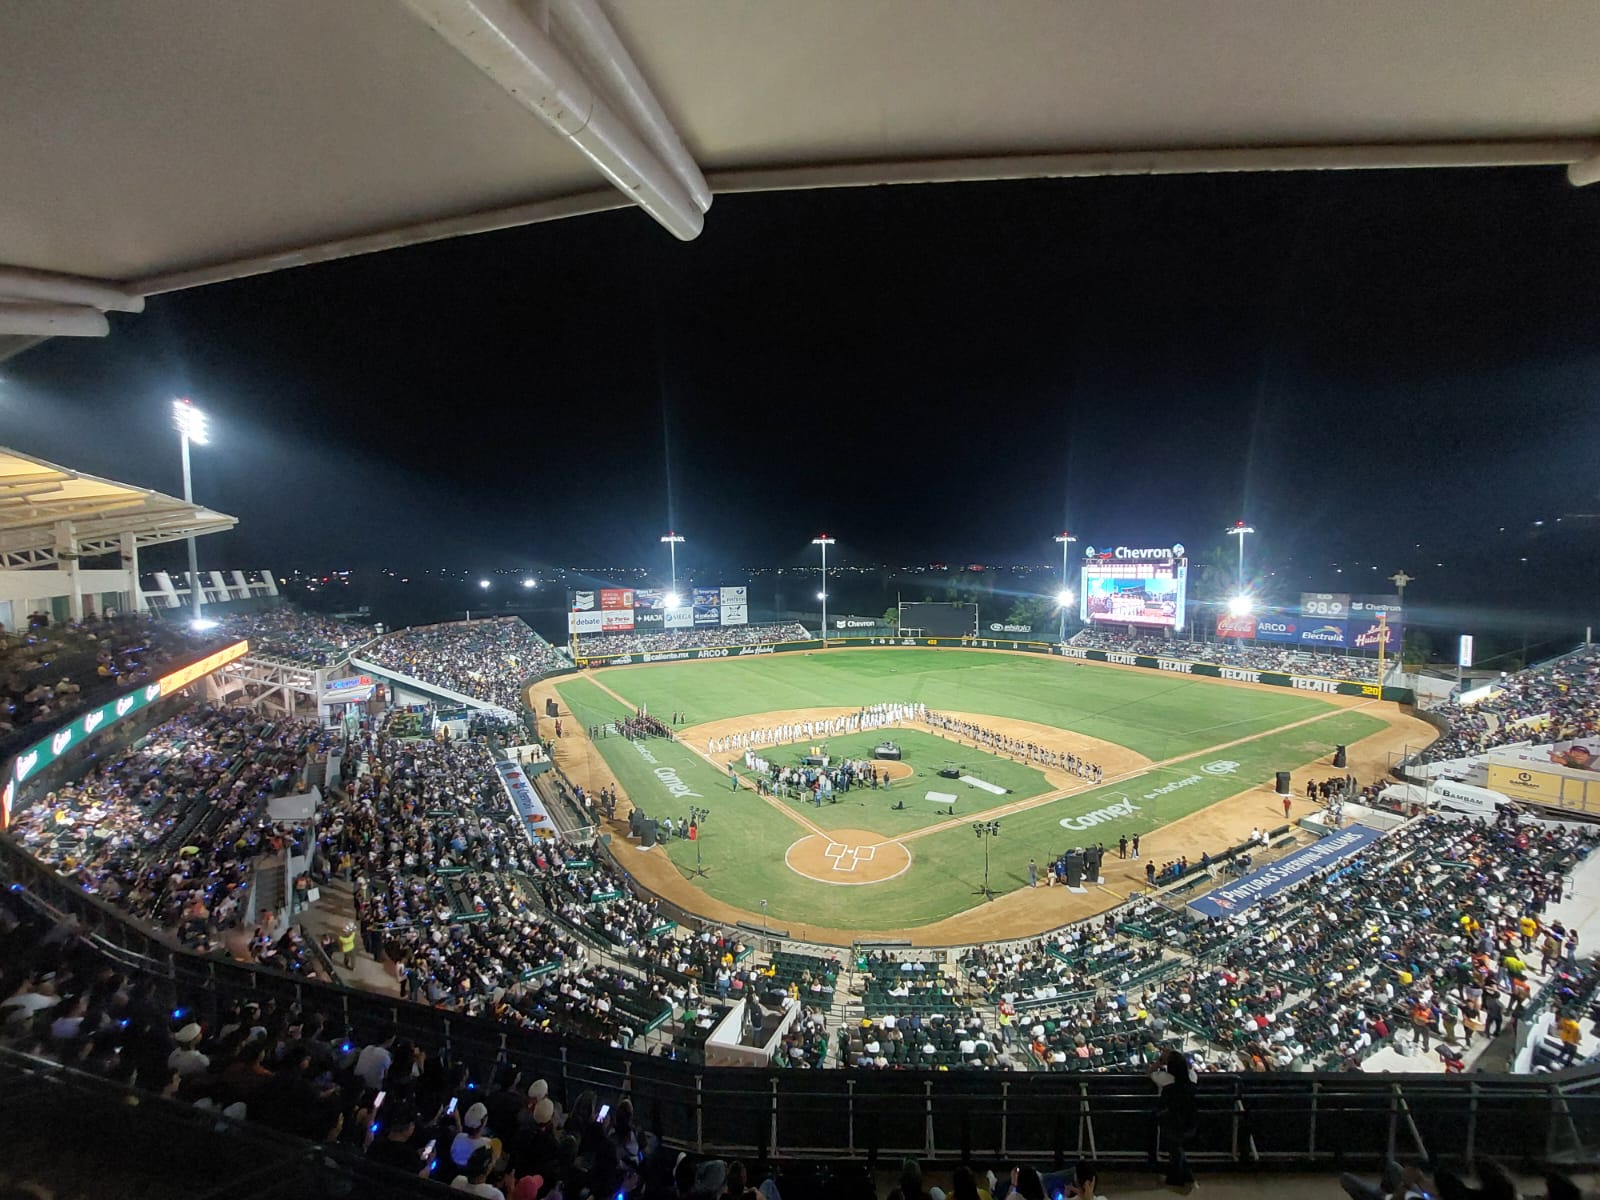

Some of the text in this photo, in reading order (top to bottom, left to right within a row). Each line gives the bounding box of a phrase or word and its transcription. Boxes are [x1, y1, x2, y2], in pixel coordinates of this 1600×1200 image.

[1115, 546, 1172, 558] Chevron
[1307, 601, 1342, 614] 98.9
[1218, 620, 1252, 632] Coca-Cola
[1258, 623, 1287, 632] ARCO
[1302, 632, 1344, 641] Electrolit
[698, 649, 721, 658] ARCO
[1060, 647, 1087, 659] TECATE
[1105, 652, 1136, 665] TECATE
[1157, 659, 1193, 674] TECATE
[1218, 667, 1263, 683] TECATE
[1289, 676, 1342, 694] TECATE
[1361, 686, 1378, 696] 320
[654, 767, 705, 798] Comex
[1442, 789, 1484, 805] BAMBAM
[1059, 797, 1143, 831] Comex
[1219, 831, 1365, 903] PINTURAS SHERWIN-WILLIAMS
